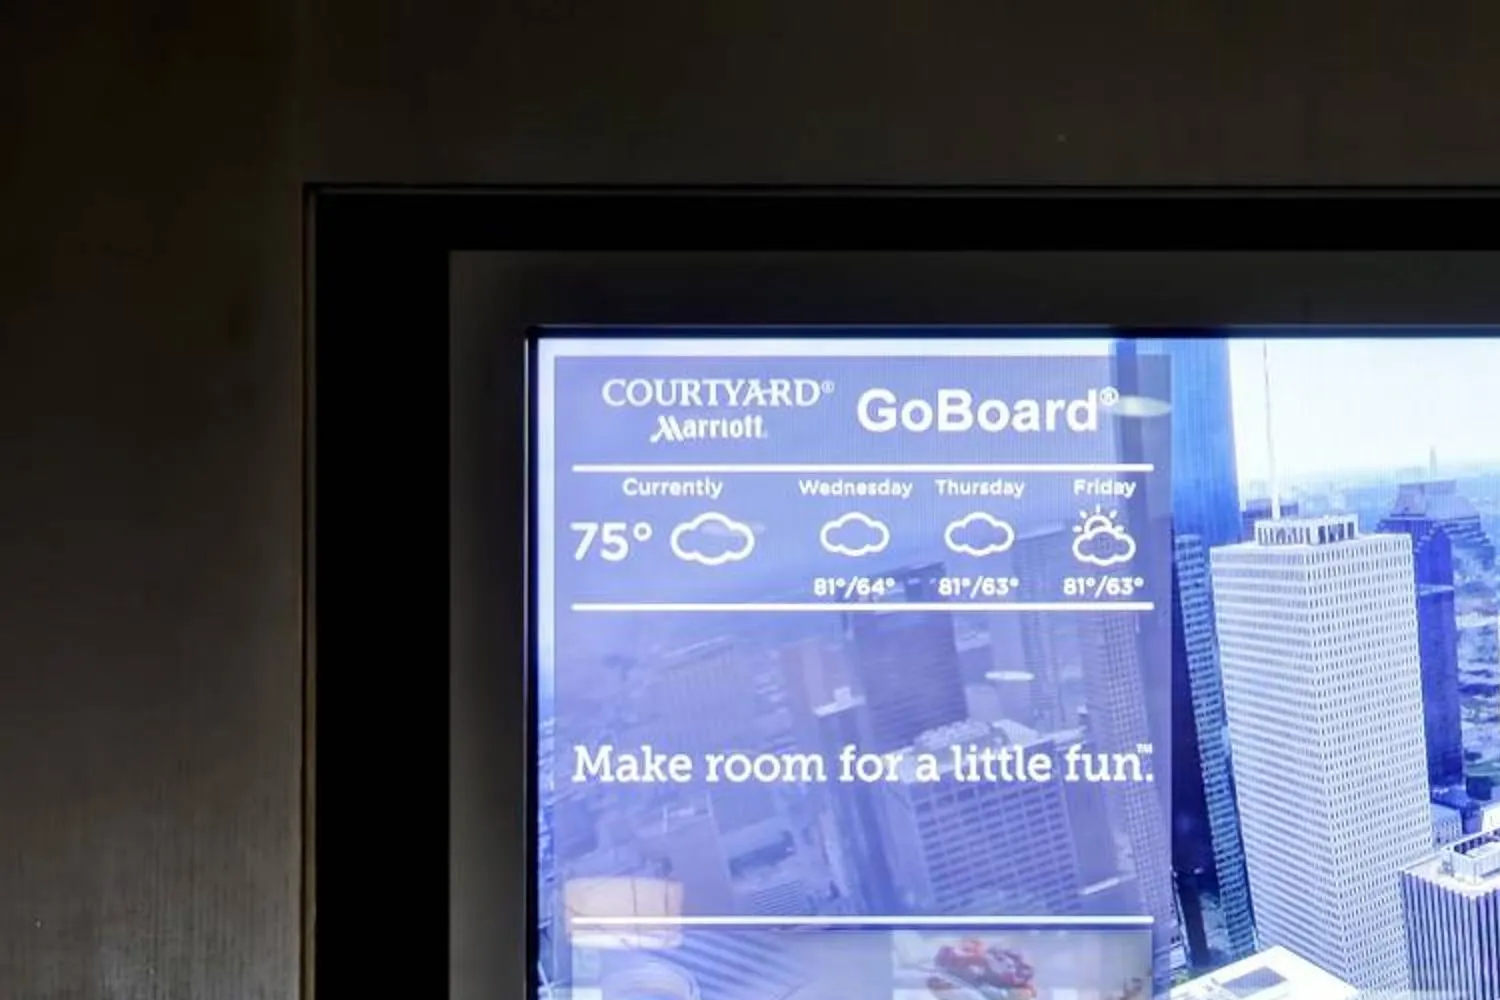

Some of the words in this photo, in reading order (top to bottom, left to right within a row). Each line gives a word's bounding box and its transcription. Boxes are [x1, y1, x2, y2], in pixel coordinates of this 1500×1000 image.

[622, 477, 724, 499] Currently
[799, 478, 913, 499] Wednesday
[936, 478, 1025, 499] Thursday
[1073, 477, 1137, 499] Friday
[570, 522, 652, 562] 75°
[814, 576, 896, 598] 81°/64°
[938, 576, 1020, 598] 81°/63°
[1063, 576, 1144, 598] 81°/63°
[572, 744, 693, 783] Make
[705, 754, 827, 783] room
[839, 744, 903, 783] for
[917, 754, 941, 783] a
[953, 744, 1052, 783] little
